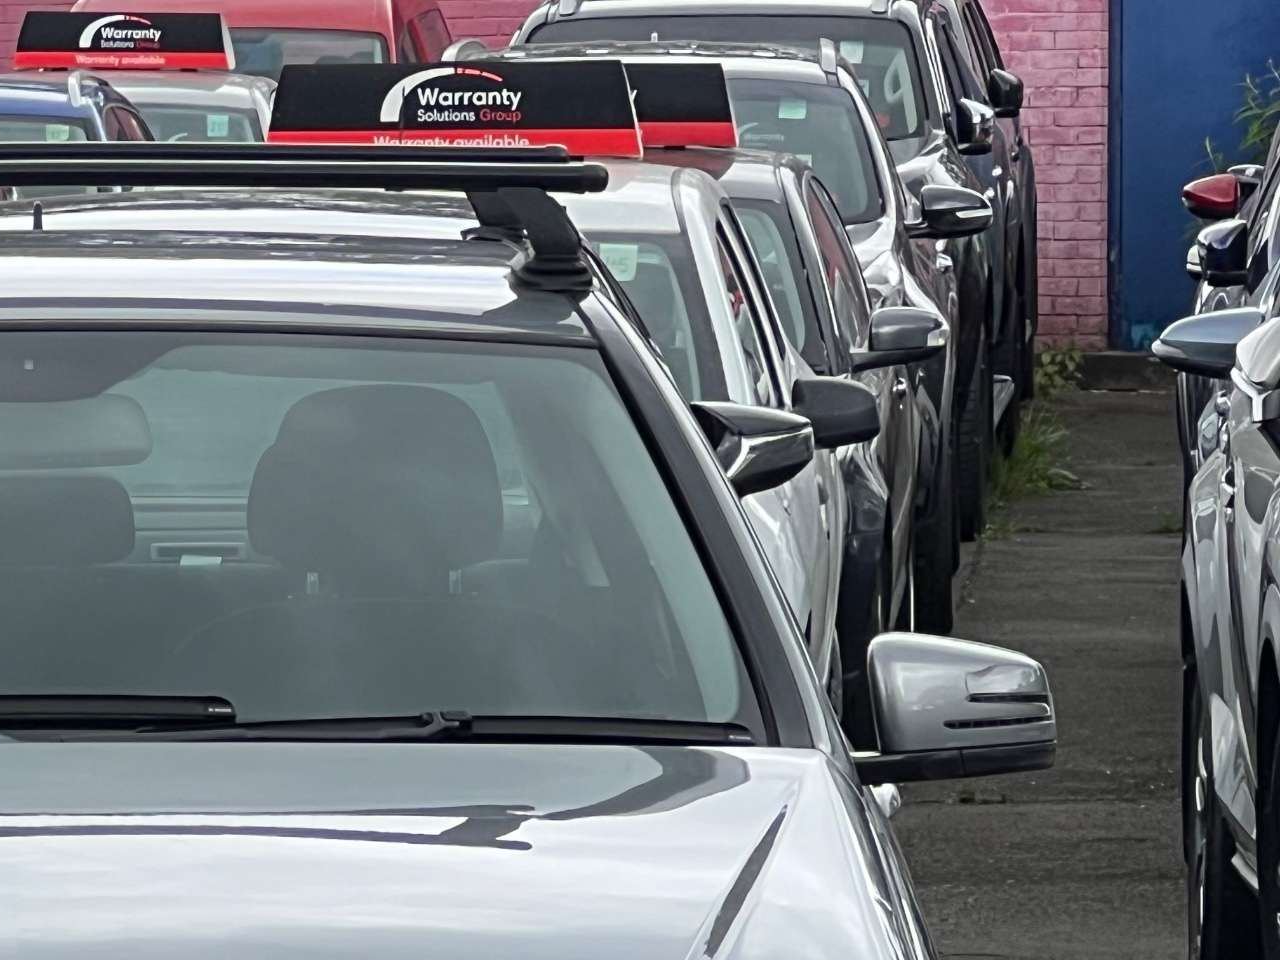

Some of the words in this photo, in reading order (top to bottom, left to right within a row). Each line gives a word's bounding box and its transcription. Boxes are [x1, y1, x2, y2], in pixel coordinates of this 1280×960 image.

[100, 26, 162, 42] Warranty
[417, 87, 522, 111] Warranty
[417, 108, 476, 122] Solutions
[479, 108, 522, 124] Group
